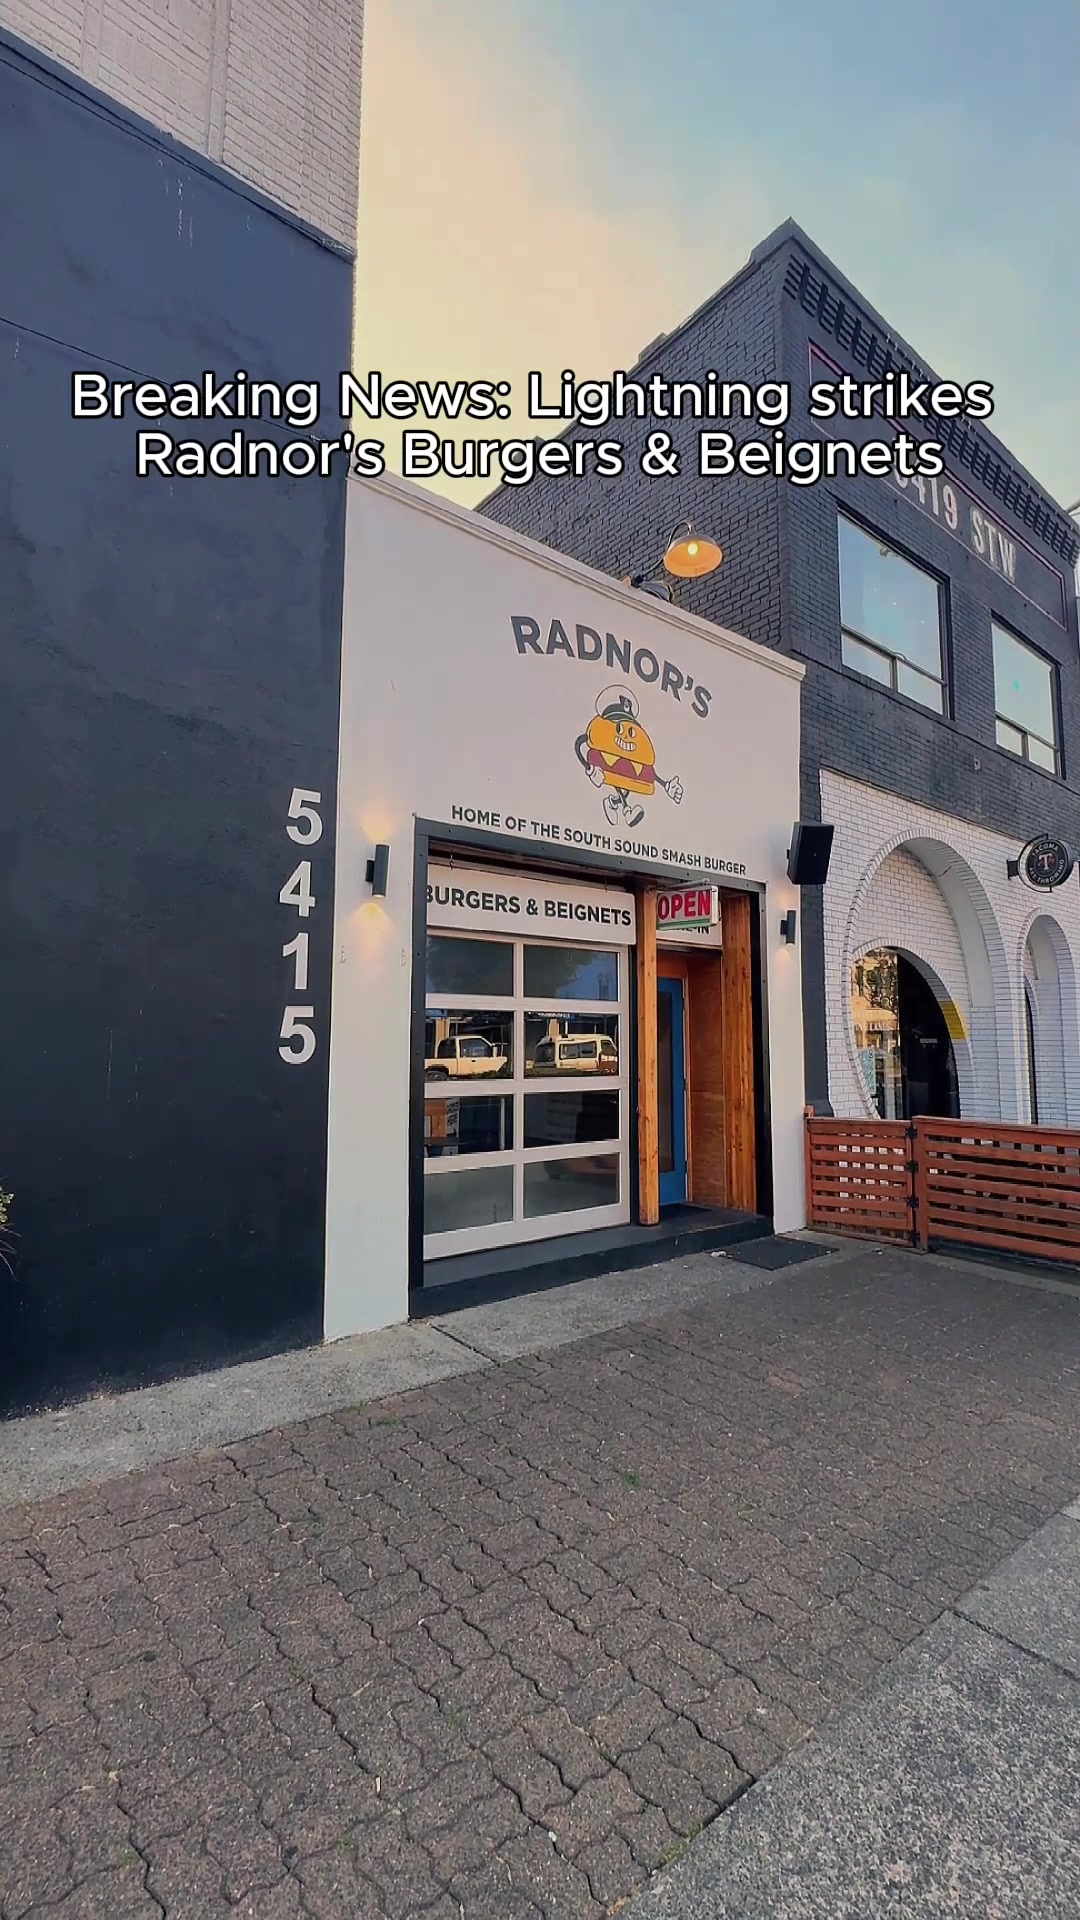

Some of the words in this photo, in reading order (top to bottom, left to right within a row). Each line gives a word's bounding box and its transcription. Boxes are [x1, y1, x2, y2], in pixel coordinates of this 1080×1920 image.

[451, 805, 501, 827] HOME
[505, 816, 527, 832] OF
[530, 821, 560, 840] THE
[563, 828, 611, 850] SOUTH
[614, 839, 659, 858] SOUND
[661, 848, 701, 867] SMASH
[704, 856, 746, 876] BURGER
[1031, 842, 1059, 857] TACOMA
[525, 898, 539, 916] &
[544, 900, 632, 926] BEIGNETS
[657, 889, 711, 920] OPEN
